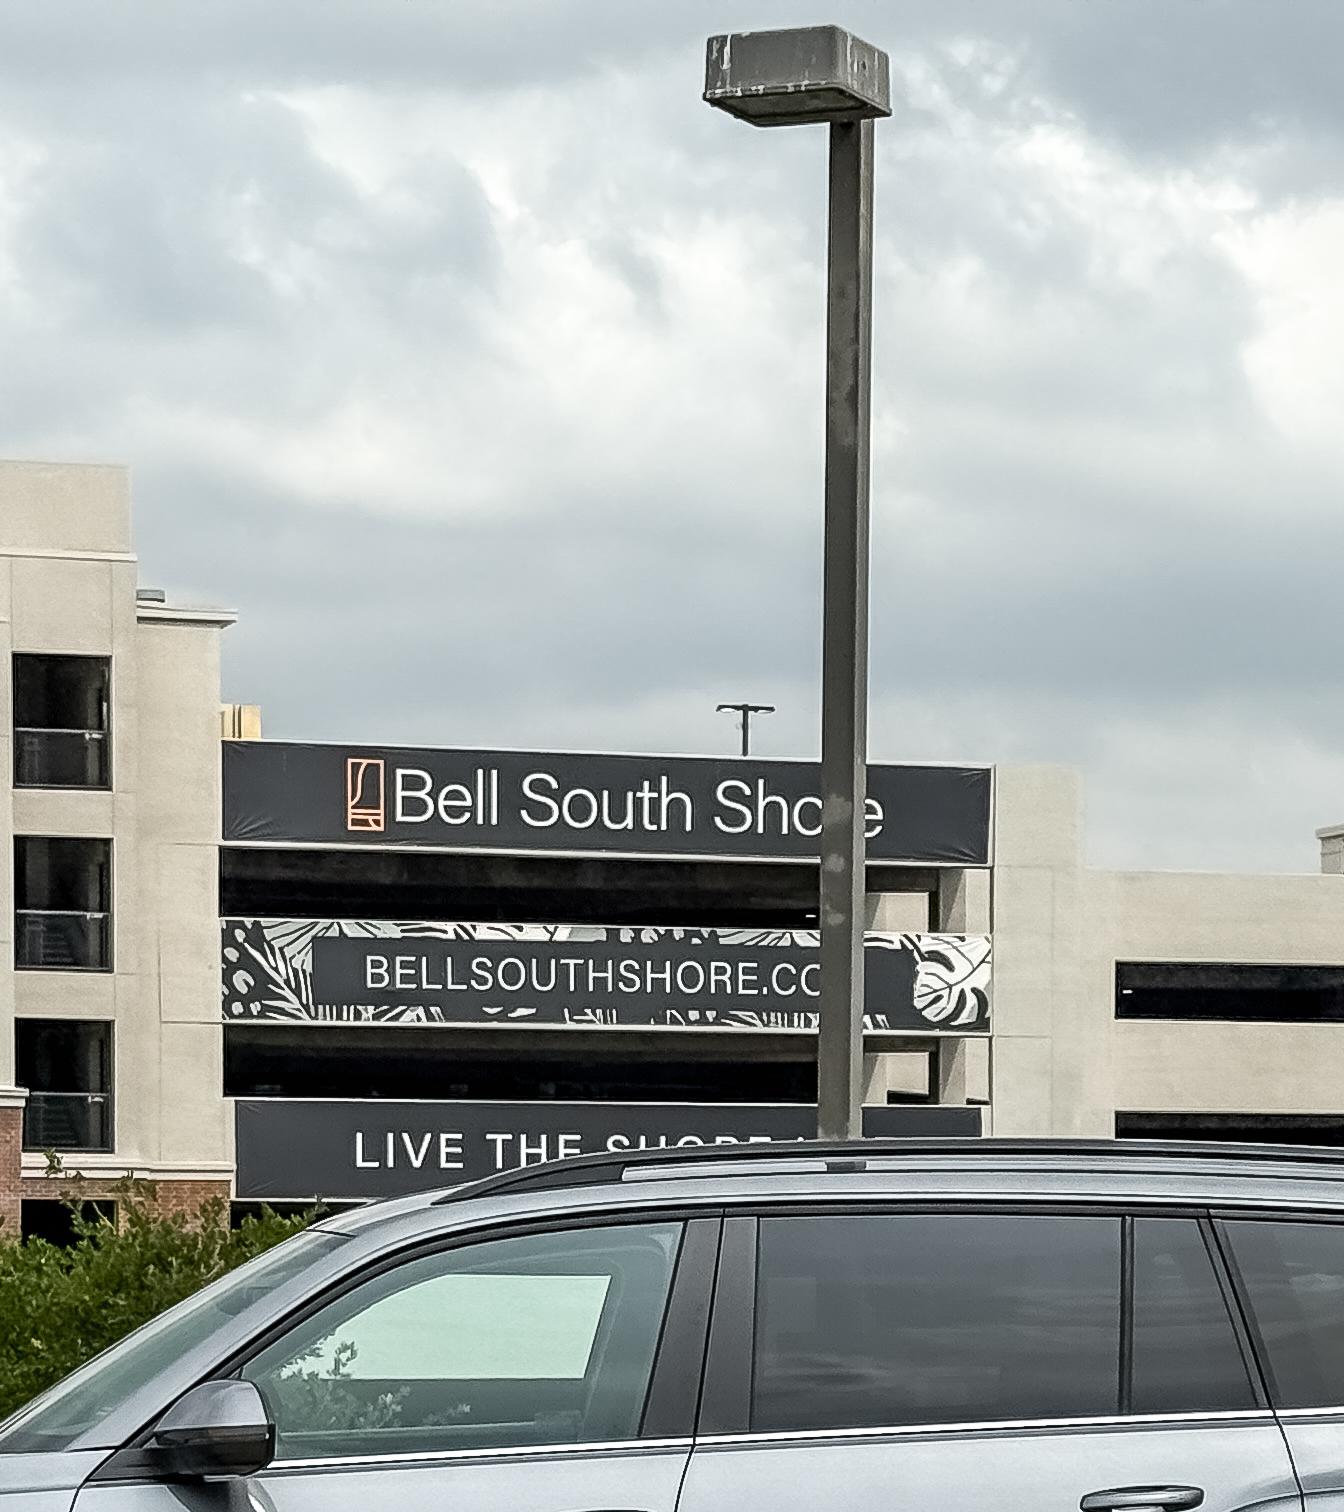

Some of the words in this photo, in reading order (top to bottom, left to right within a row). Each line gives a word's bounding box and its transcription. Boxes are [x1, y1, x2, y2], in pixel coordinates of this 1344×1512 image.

[396, 769, 497, 825] Bell
[521, 774, 691, 831] South
[714, 779, 884, 838] Shoe
[367, 956, 820, 996] BELLSOUTHSHORE.CO
[356, 1132, 463, 1168] LIVE
[486, 1134, 582, 1169] THE
